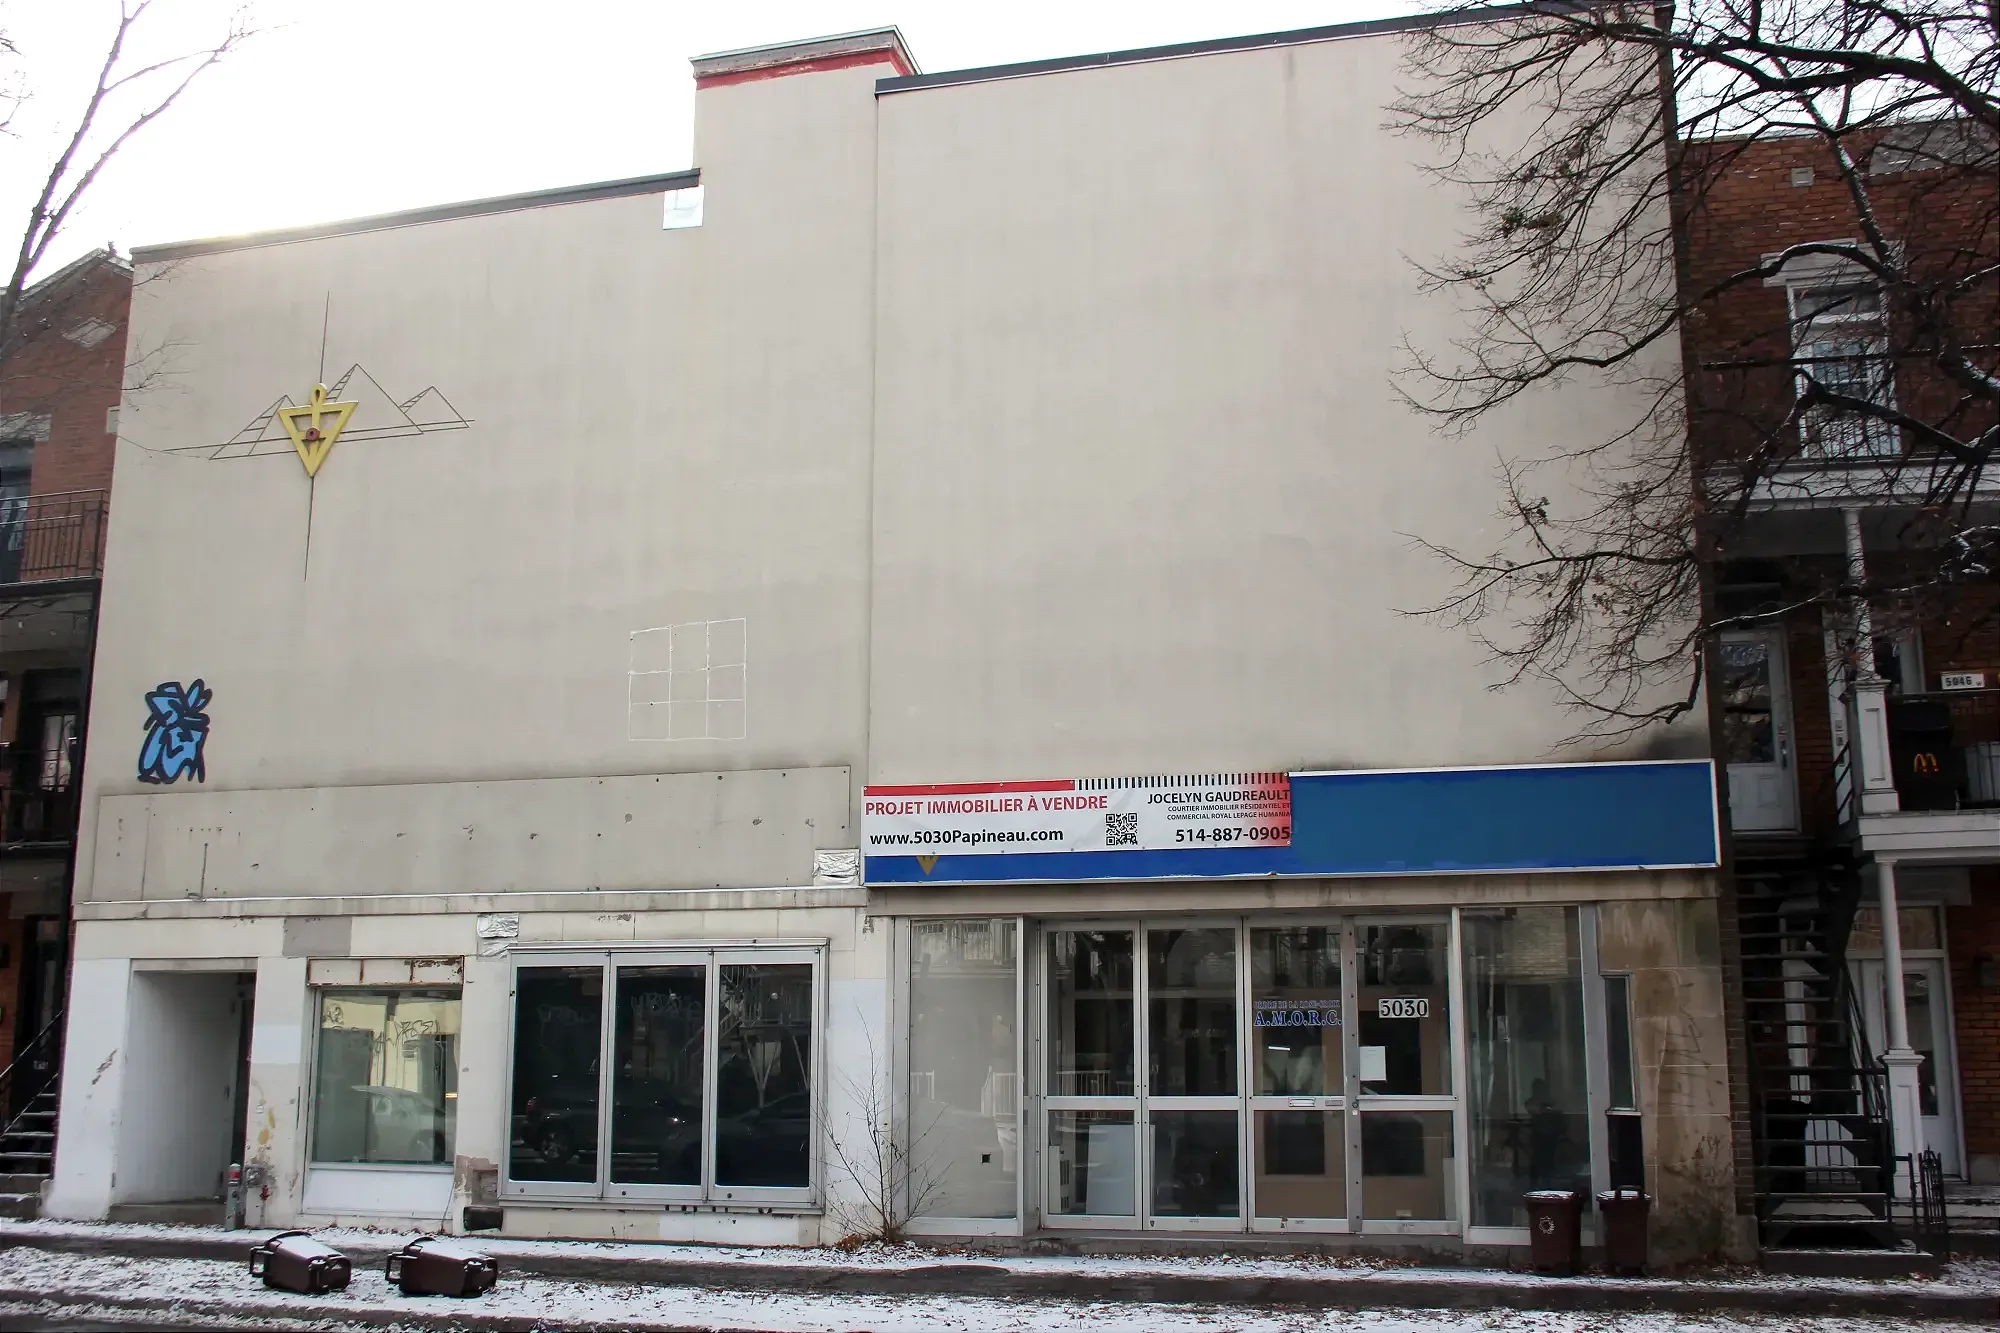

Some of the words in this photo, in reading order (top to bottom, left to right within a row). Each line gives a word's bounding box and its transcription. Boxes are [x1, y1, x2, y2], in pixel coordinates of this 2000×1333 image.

[1945, 676, 1973, 687] 5046
[1148, 792, 1201, 804] JOCELYN
[1205, 789, 1291, 802] GAUDREAULT
[865, 801, 923, 815] PROJET
[927, 798, 1023, 814] IMMOBILIER
[1027, 795, 1039, 811] À
[1042, 795, 1108, 811] VENDRE
[1240, 802, 1281, 810] RÉSIDENTIEL
[1233, 811, 1257, 819] LEPAGE
[870, 829, 1064, 846] www.5030Papineau.com
[1175, 826, 1290, 842] 514-887-0905
[1380, 1000, 1427, 1016] 5030
[1253, 1010, 1343, 1026] A.M.O.R.C.
